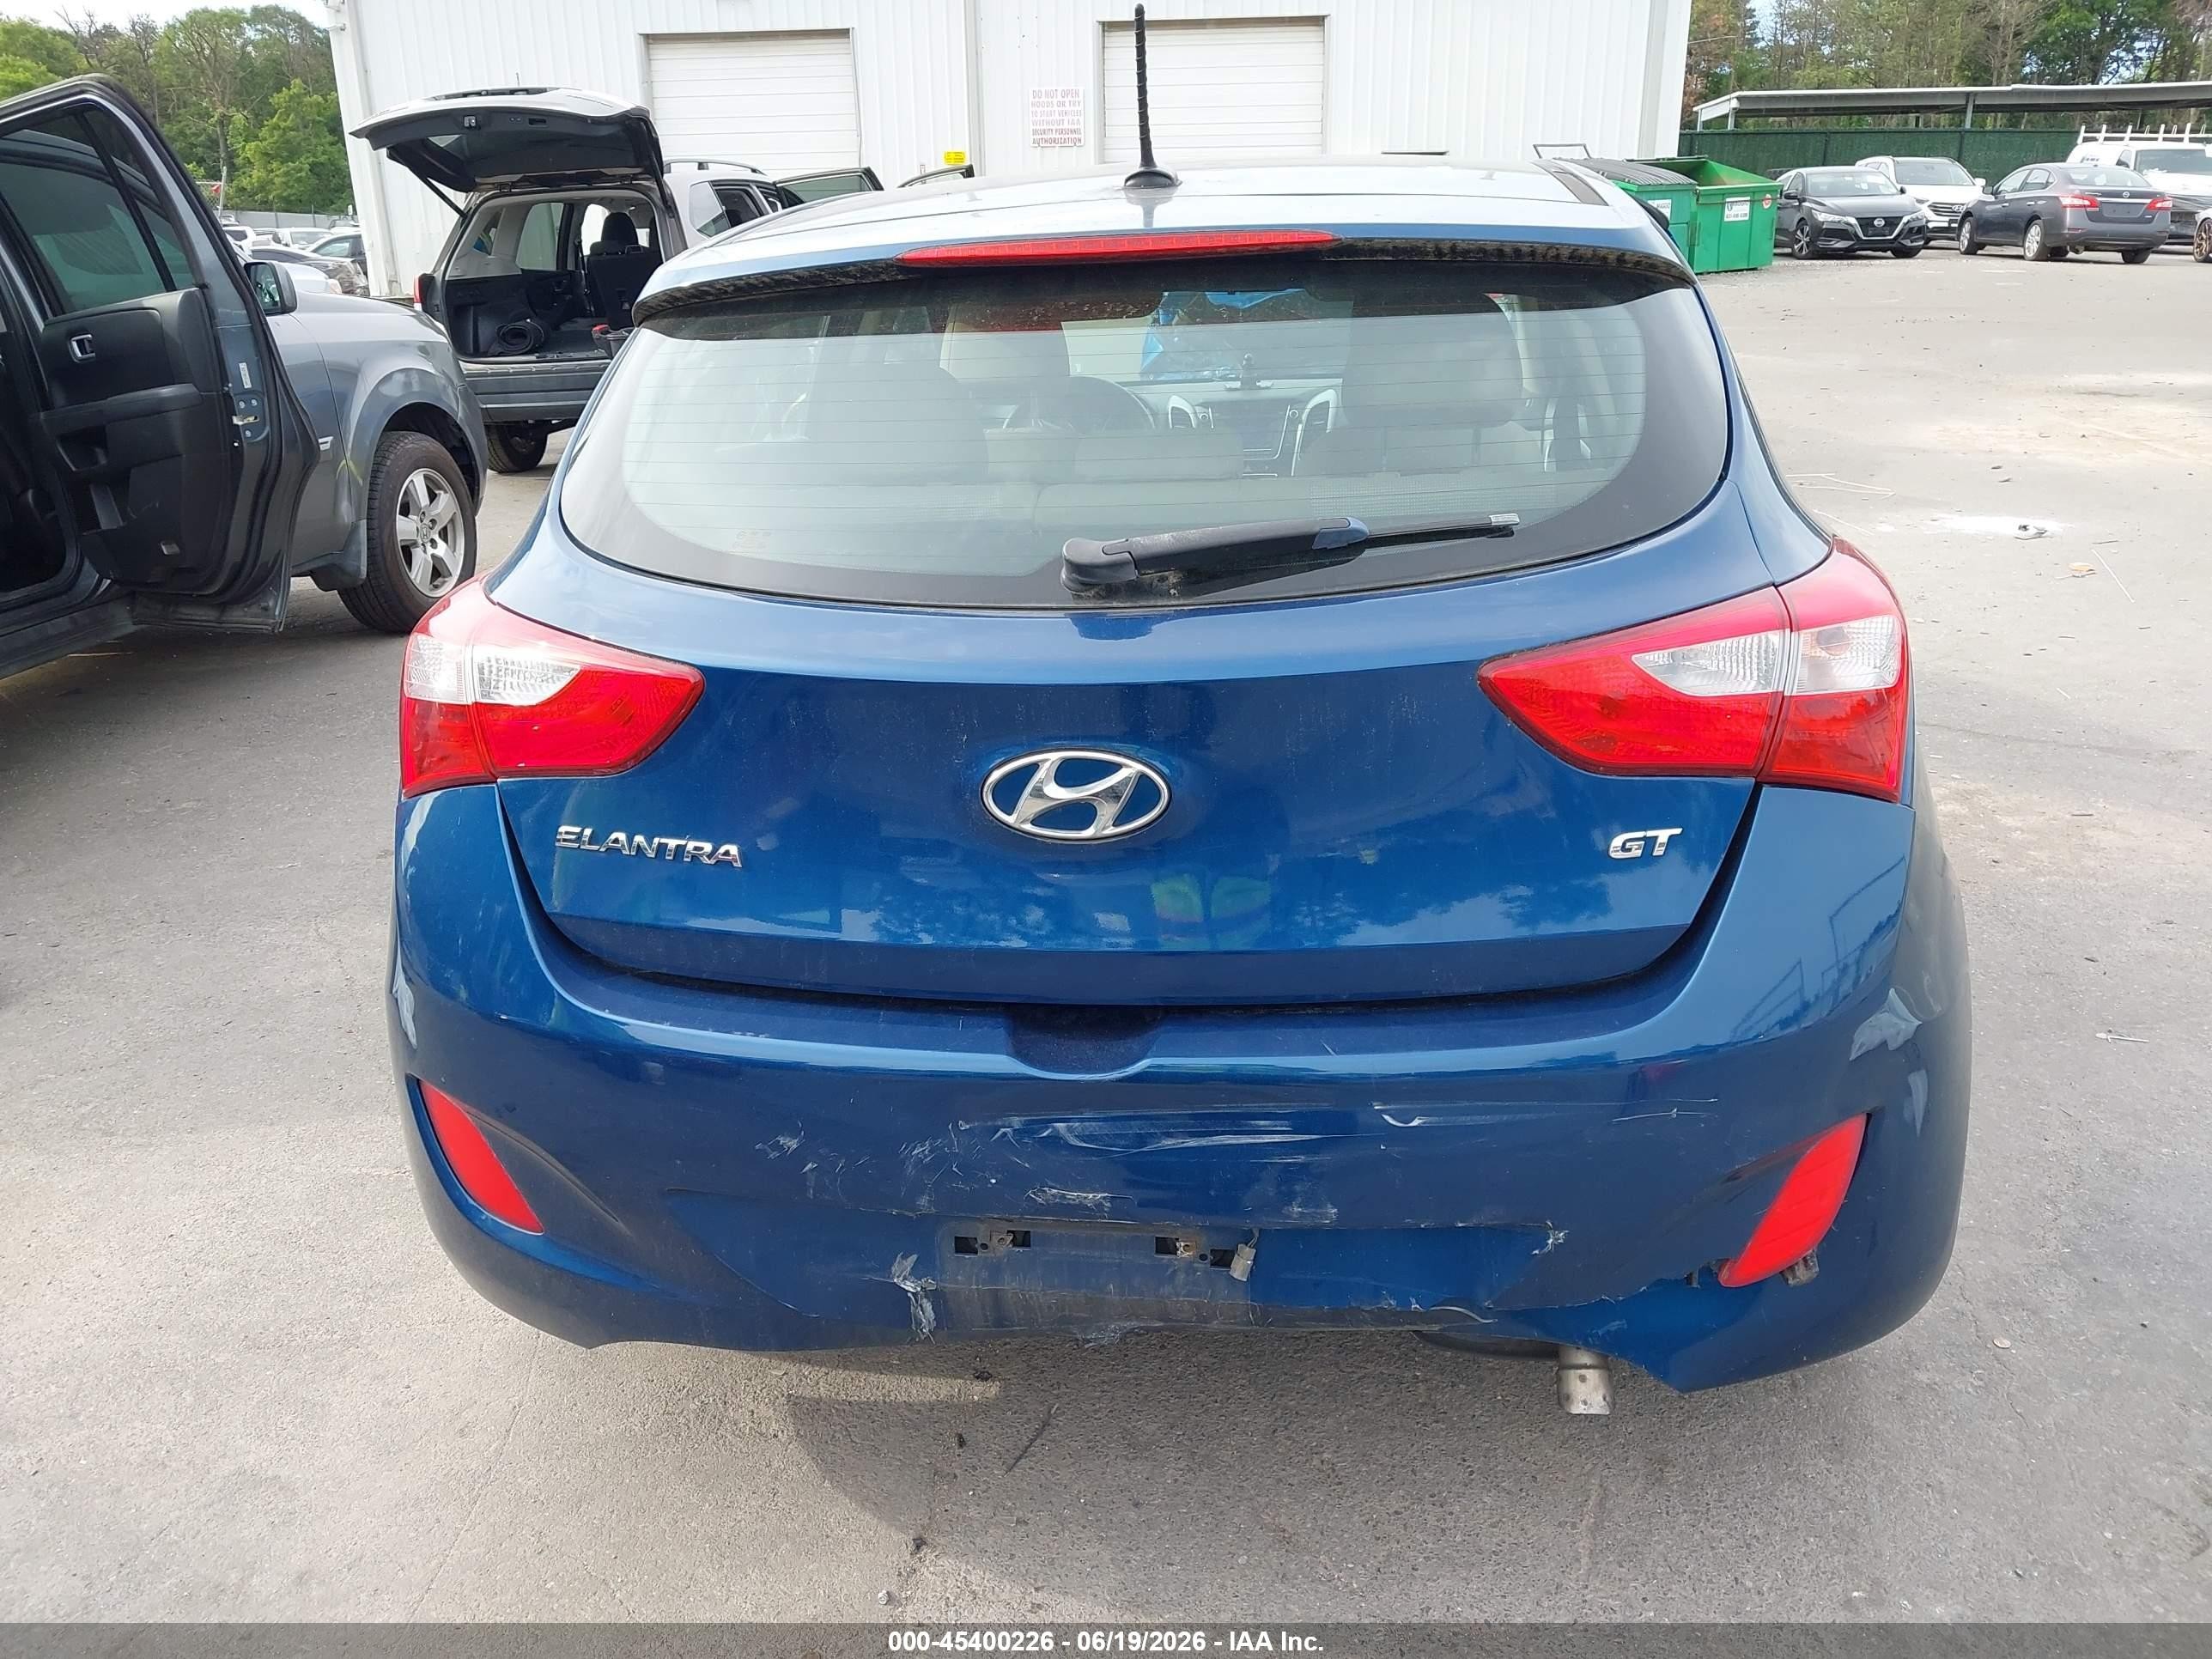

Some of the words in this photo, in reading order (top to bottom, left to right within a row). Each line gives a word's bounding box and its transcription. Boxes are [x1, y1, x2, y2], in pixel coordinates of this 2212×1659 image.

[1032, 89, 1042, 99] DO
[1044, 89, 1058, 99] NOT
[1060, 88, 1079, 99] OPEN
[555, 824, 743, 868] ELANTRA
[1608, 827, 1683, 859] GT
